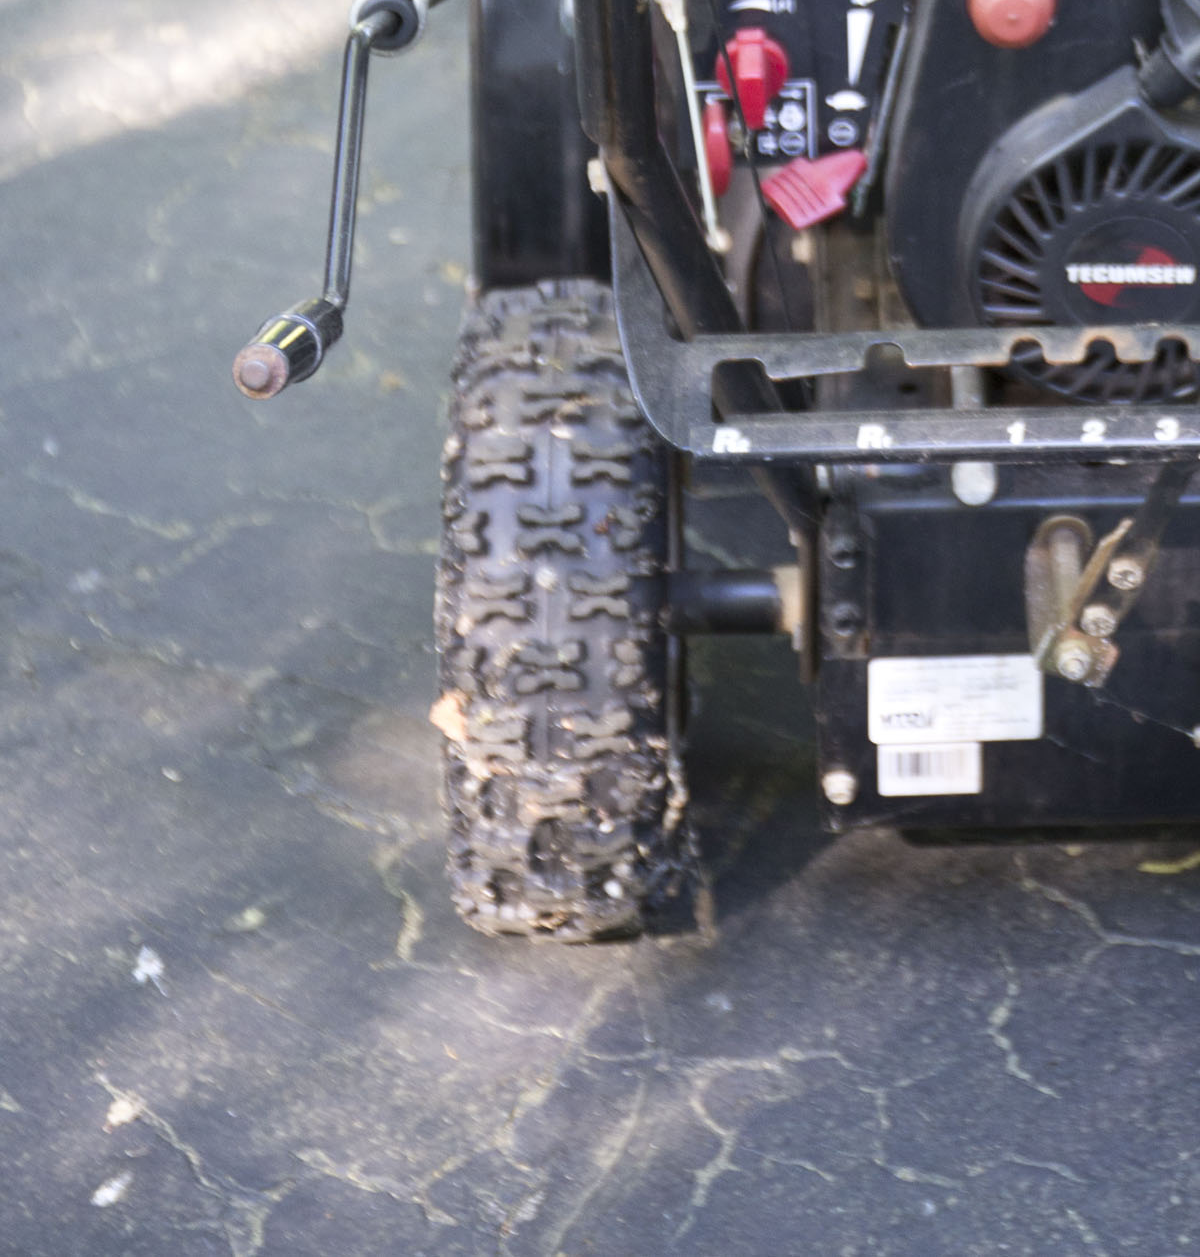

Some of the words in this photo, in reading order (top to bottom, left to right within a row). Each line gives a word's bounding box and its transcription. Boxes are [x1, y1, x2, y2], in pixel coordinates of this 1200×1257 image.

[1065, 263, 1197, 285] TECUMSEH
[1006, 420, 1026, 445] 1
[1081, 418, 1106, 443] 2
[1154, 416, 1180, 441] 3
